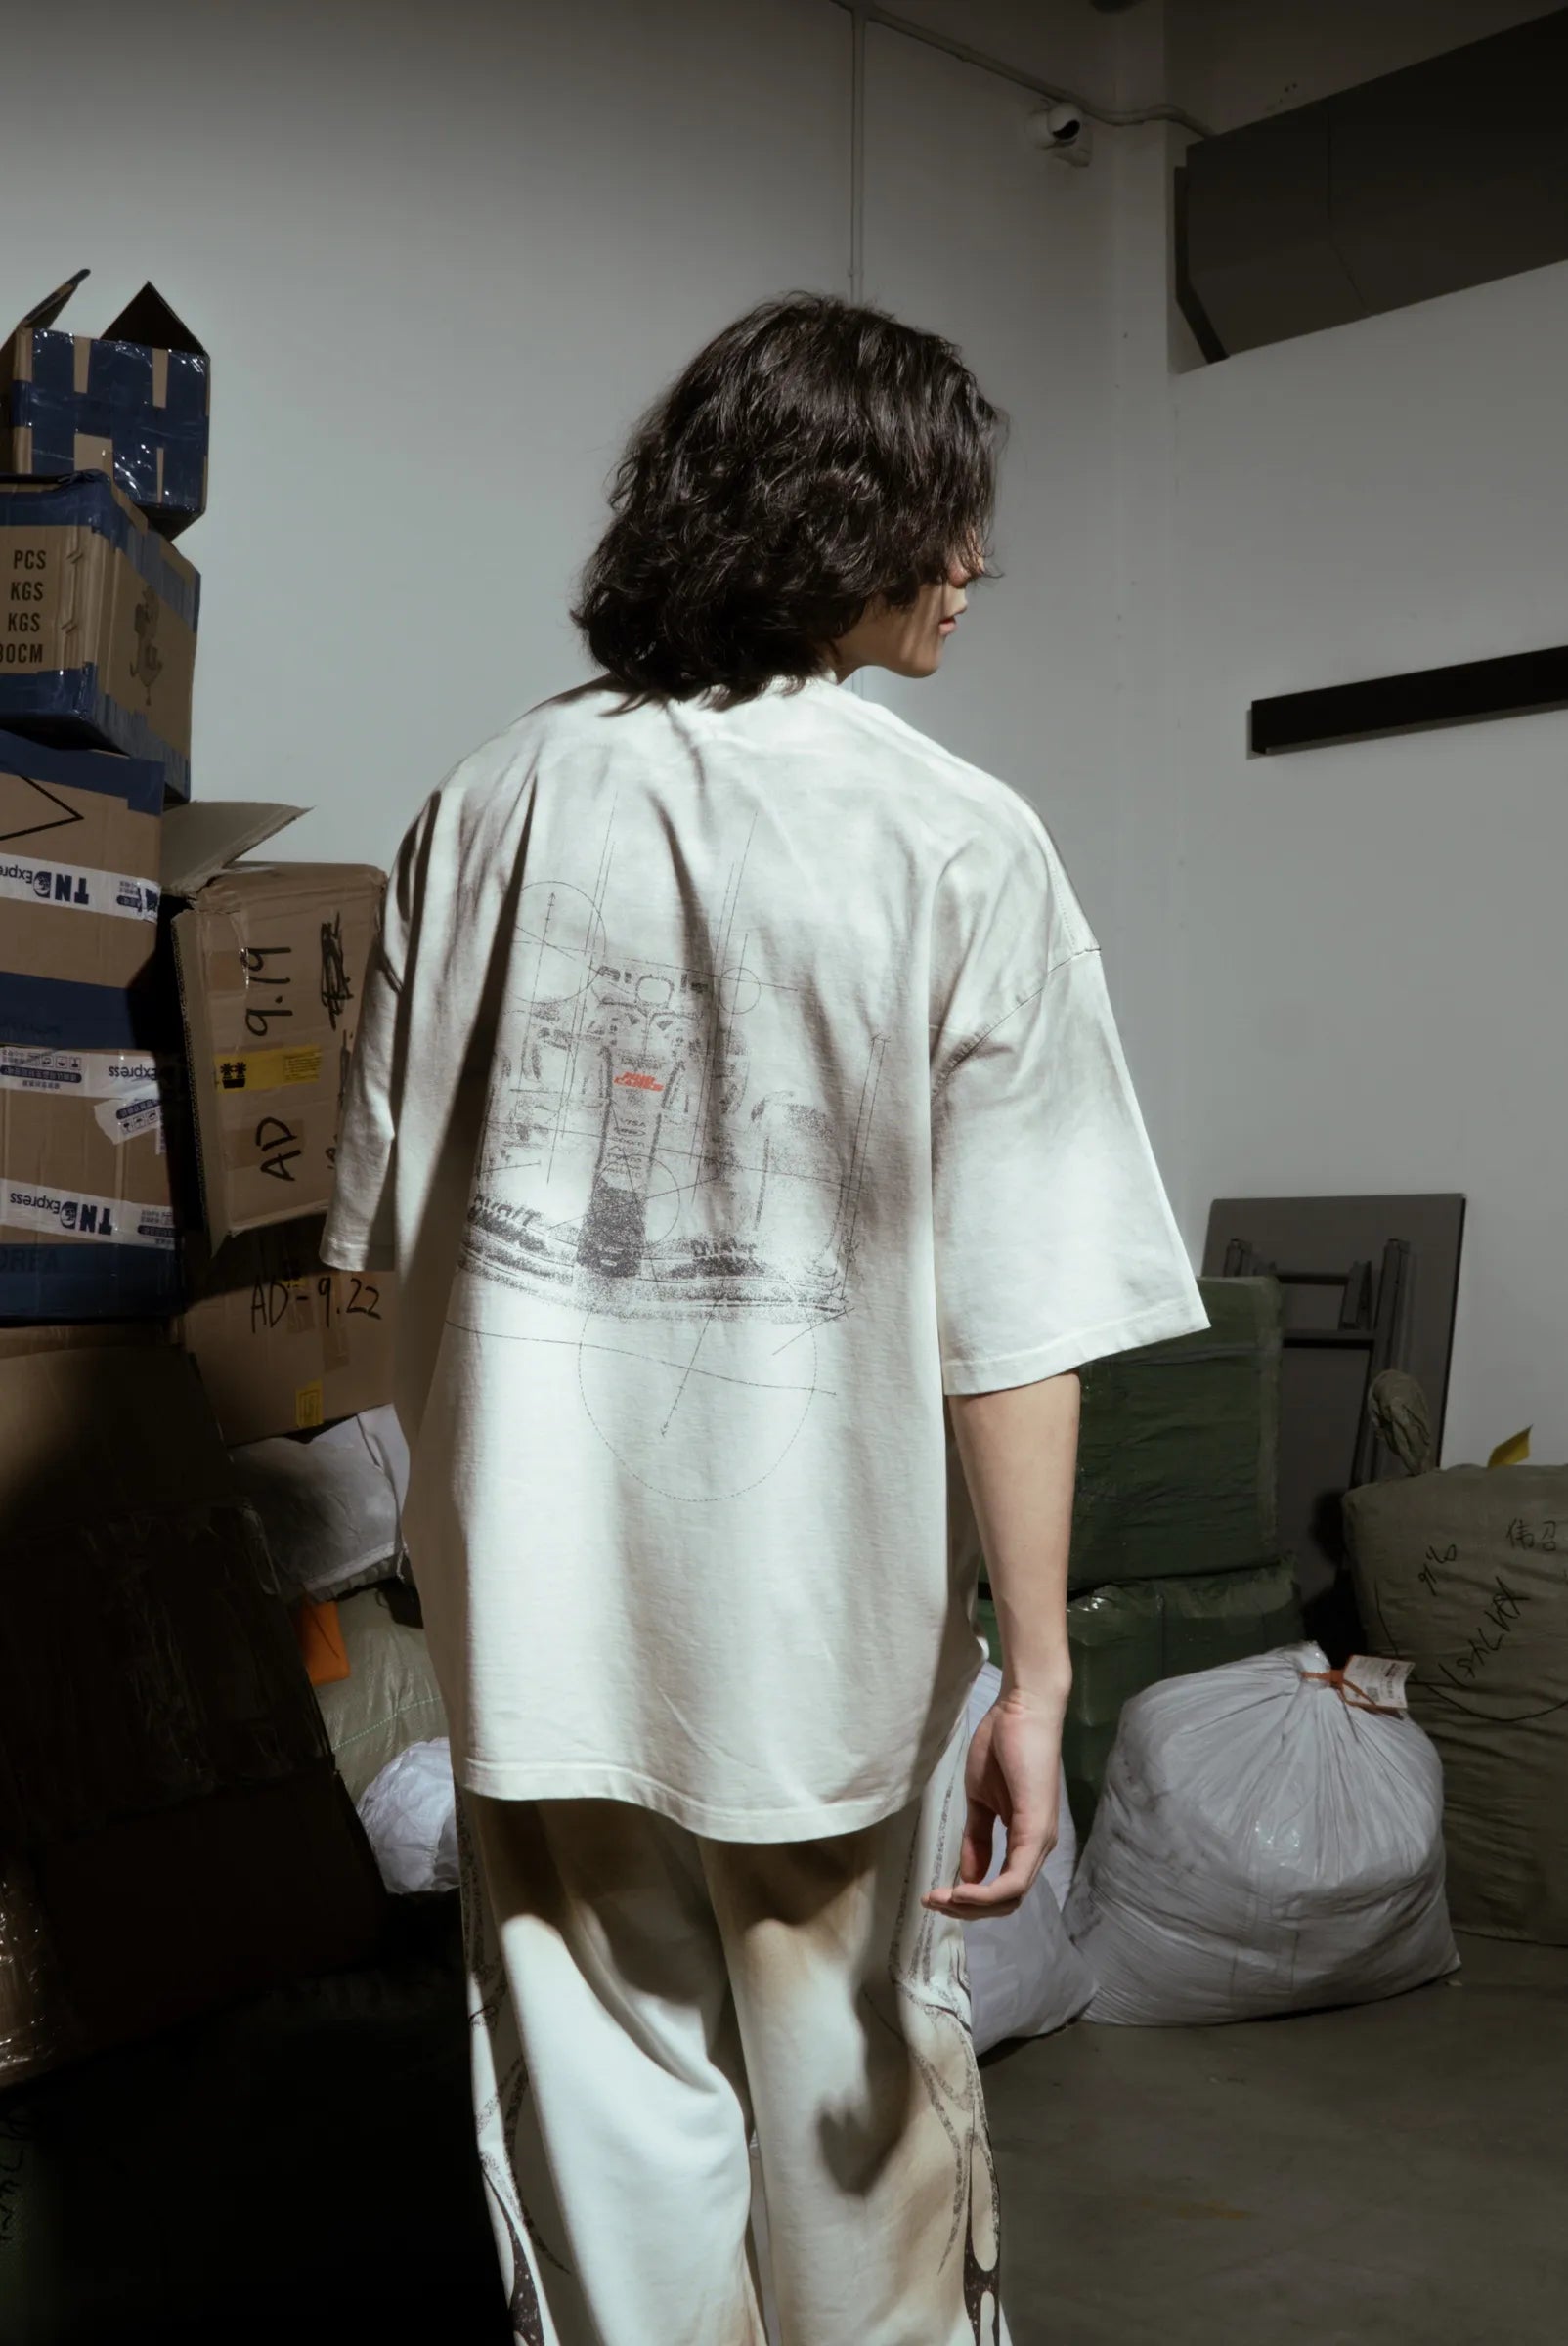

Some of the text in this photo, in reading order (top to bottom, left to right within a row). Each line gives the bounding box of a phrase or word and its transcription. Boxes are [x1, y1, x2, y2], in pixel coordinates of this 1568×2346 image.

[14, 550, 46, 569] PCS
[11, 582, 43, 601] KGS
[8, 612, 40, 632] KGS
[240, 946, 292, 1036] 9.19
[255, 1116, 303, 1181] AD
[10, 1192, 61, 1214] Express
